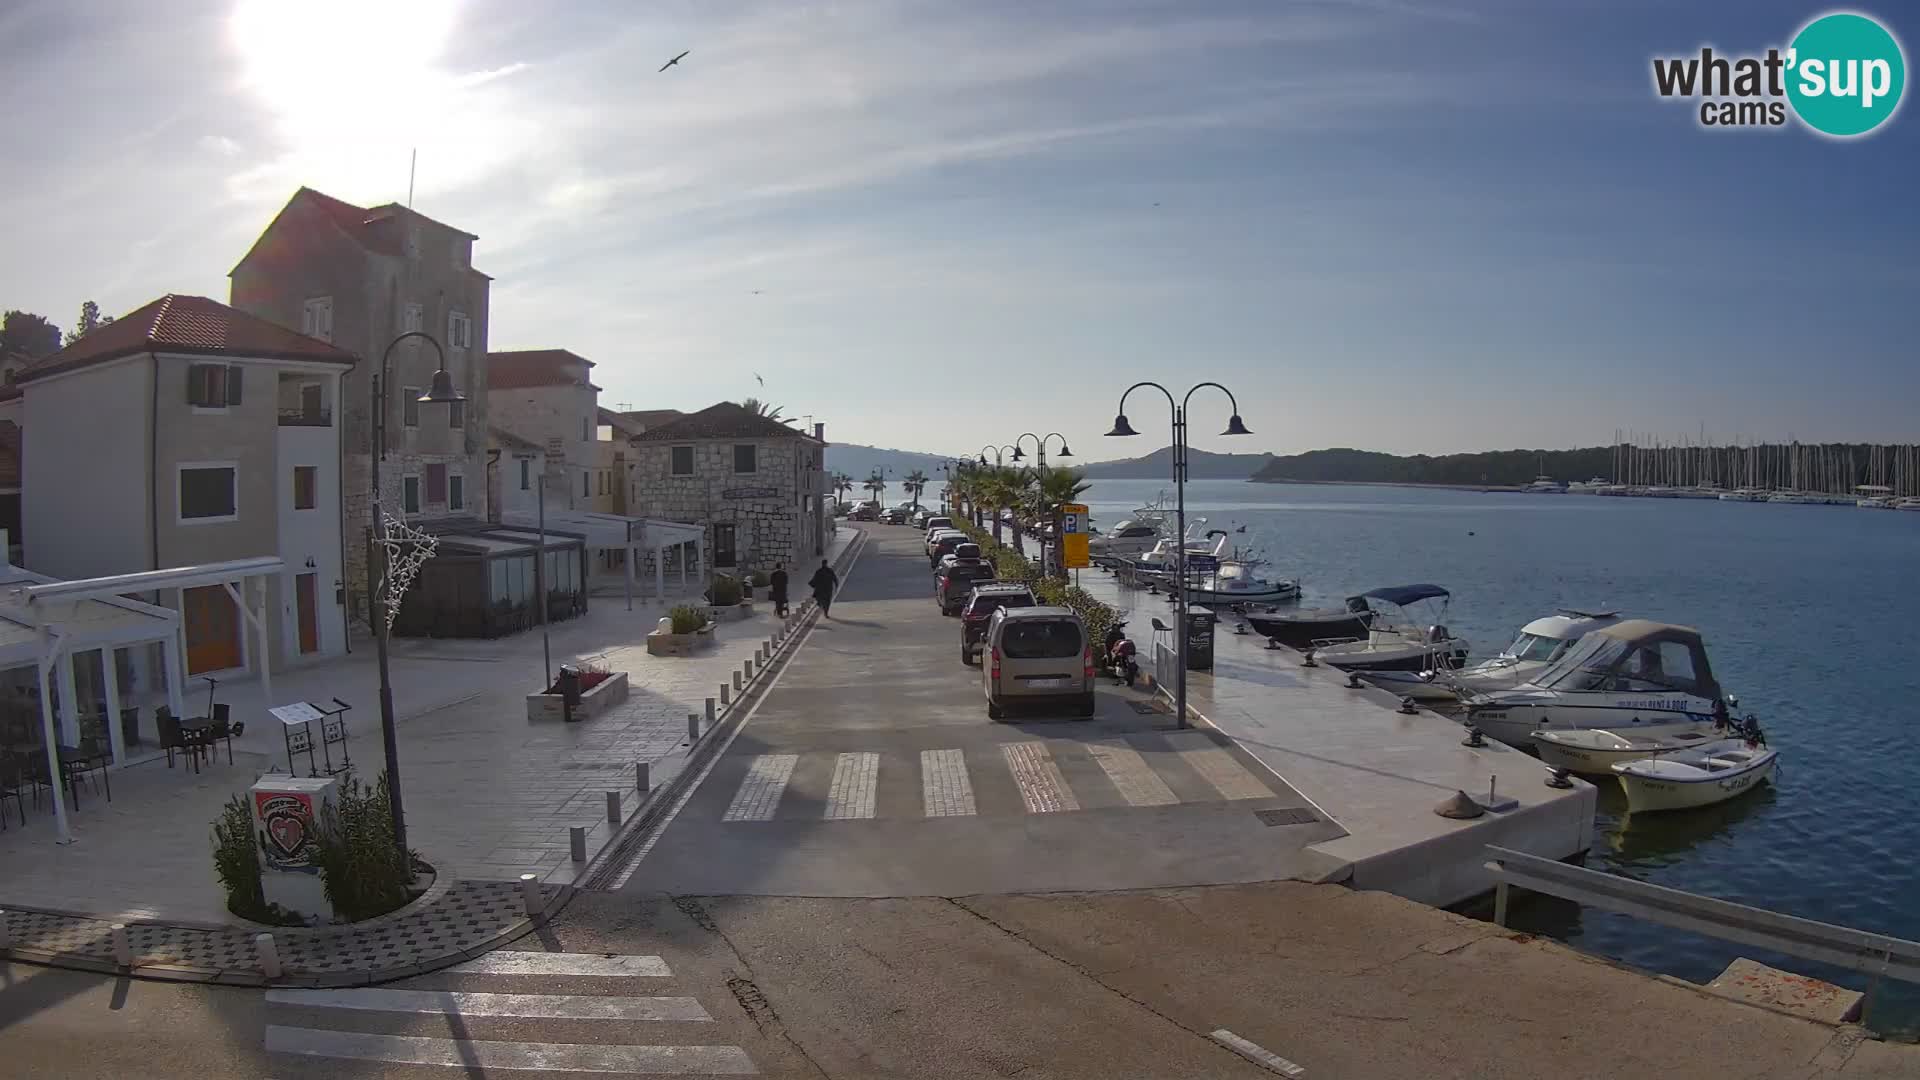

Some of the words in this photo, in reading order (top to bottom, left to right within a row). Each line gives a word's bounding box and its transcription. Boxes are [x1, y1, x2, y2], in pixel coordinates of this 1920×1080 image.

[1065, 515, 1076, 531] P
[1647, 699, 1665, 709] RENT
[1671, 700, 1689, 711] BOAT
